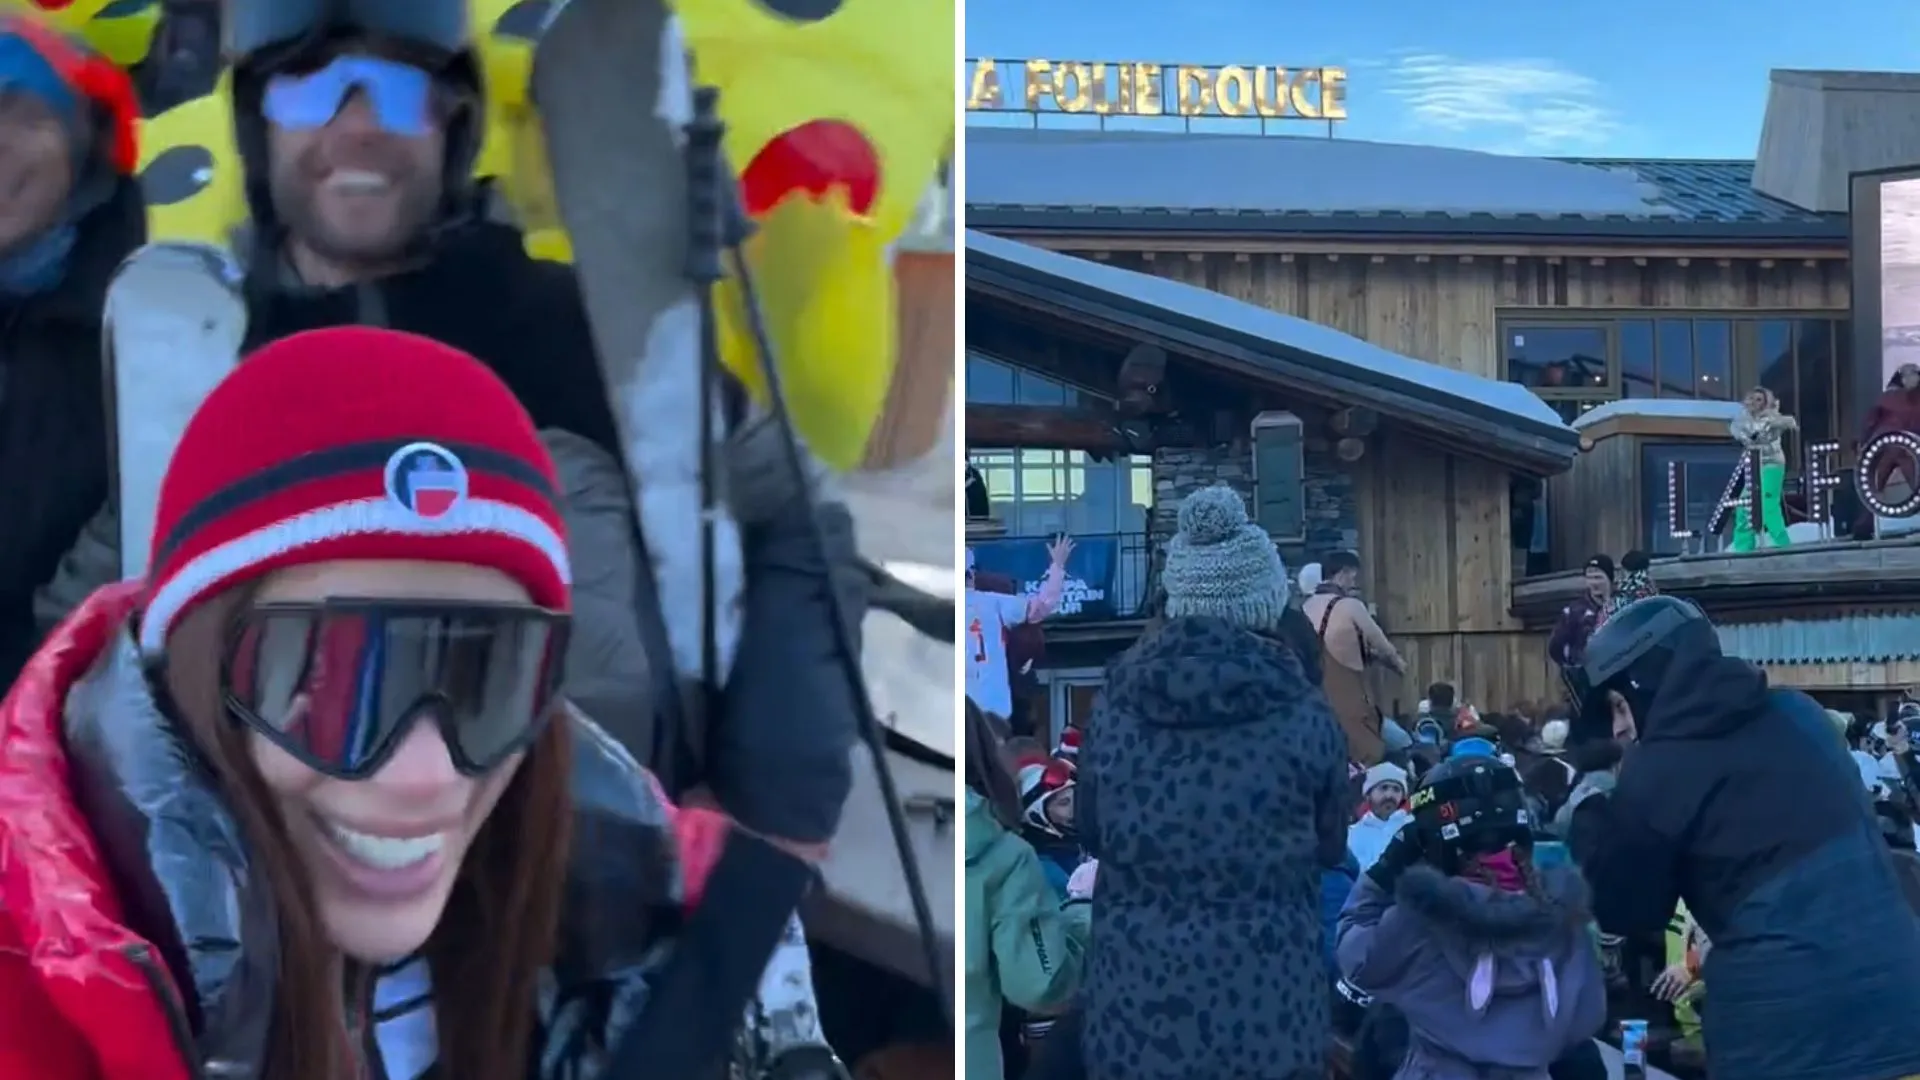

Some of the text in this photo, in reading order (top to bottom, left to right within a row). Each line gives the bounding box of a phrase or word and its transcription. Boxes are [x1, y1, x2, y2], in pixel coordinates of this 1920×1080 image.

[1024, 59, 1164, 116] FOLIE
[1178, 64, 1348, 120] DOUCE
[1668, 449, 1763, 540] LA
